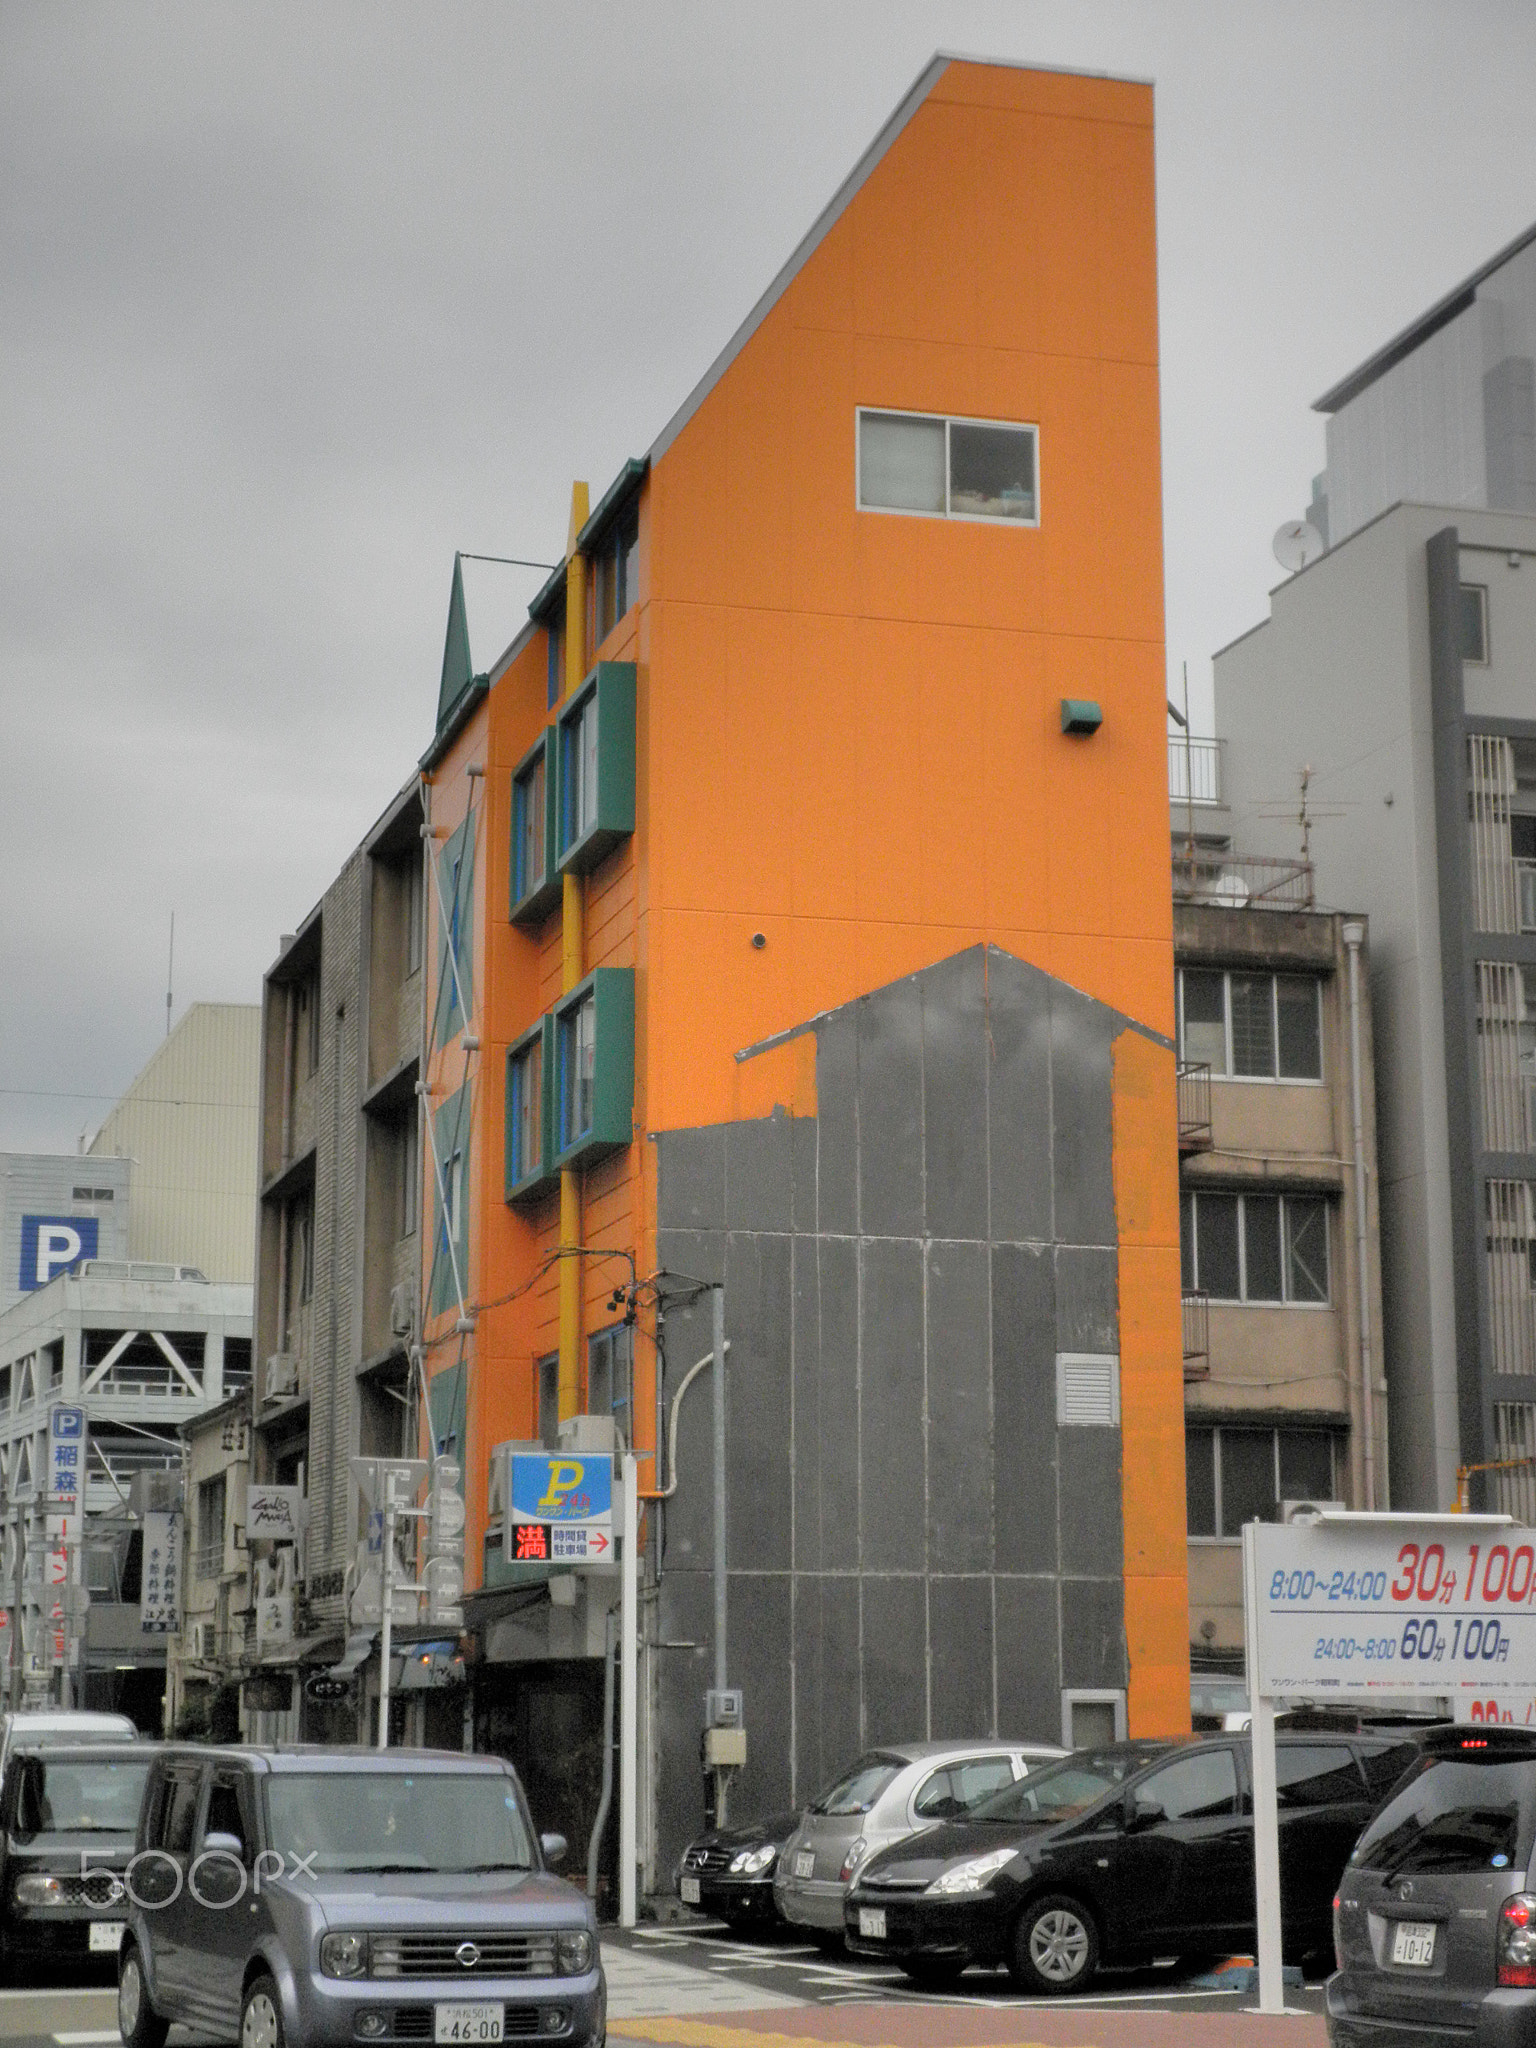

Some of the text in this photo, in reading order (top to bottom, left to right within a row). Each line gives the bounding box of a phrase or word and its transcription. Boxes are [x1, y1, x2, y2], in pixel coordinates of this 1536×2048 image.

[36, 1225, 81, 1283] P
[58, 1414, 77, 1433] P
[537, 1460, 584, 1506] P
[559, 1493, 590, 1506] 24h
[516, 1524, 546, 1559] 満
[553, 1530, 587, 1541] 時間貸
[553, 1544, 588, 1556] 駐車場
[1464, 1544, 1536, 1605] 100
